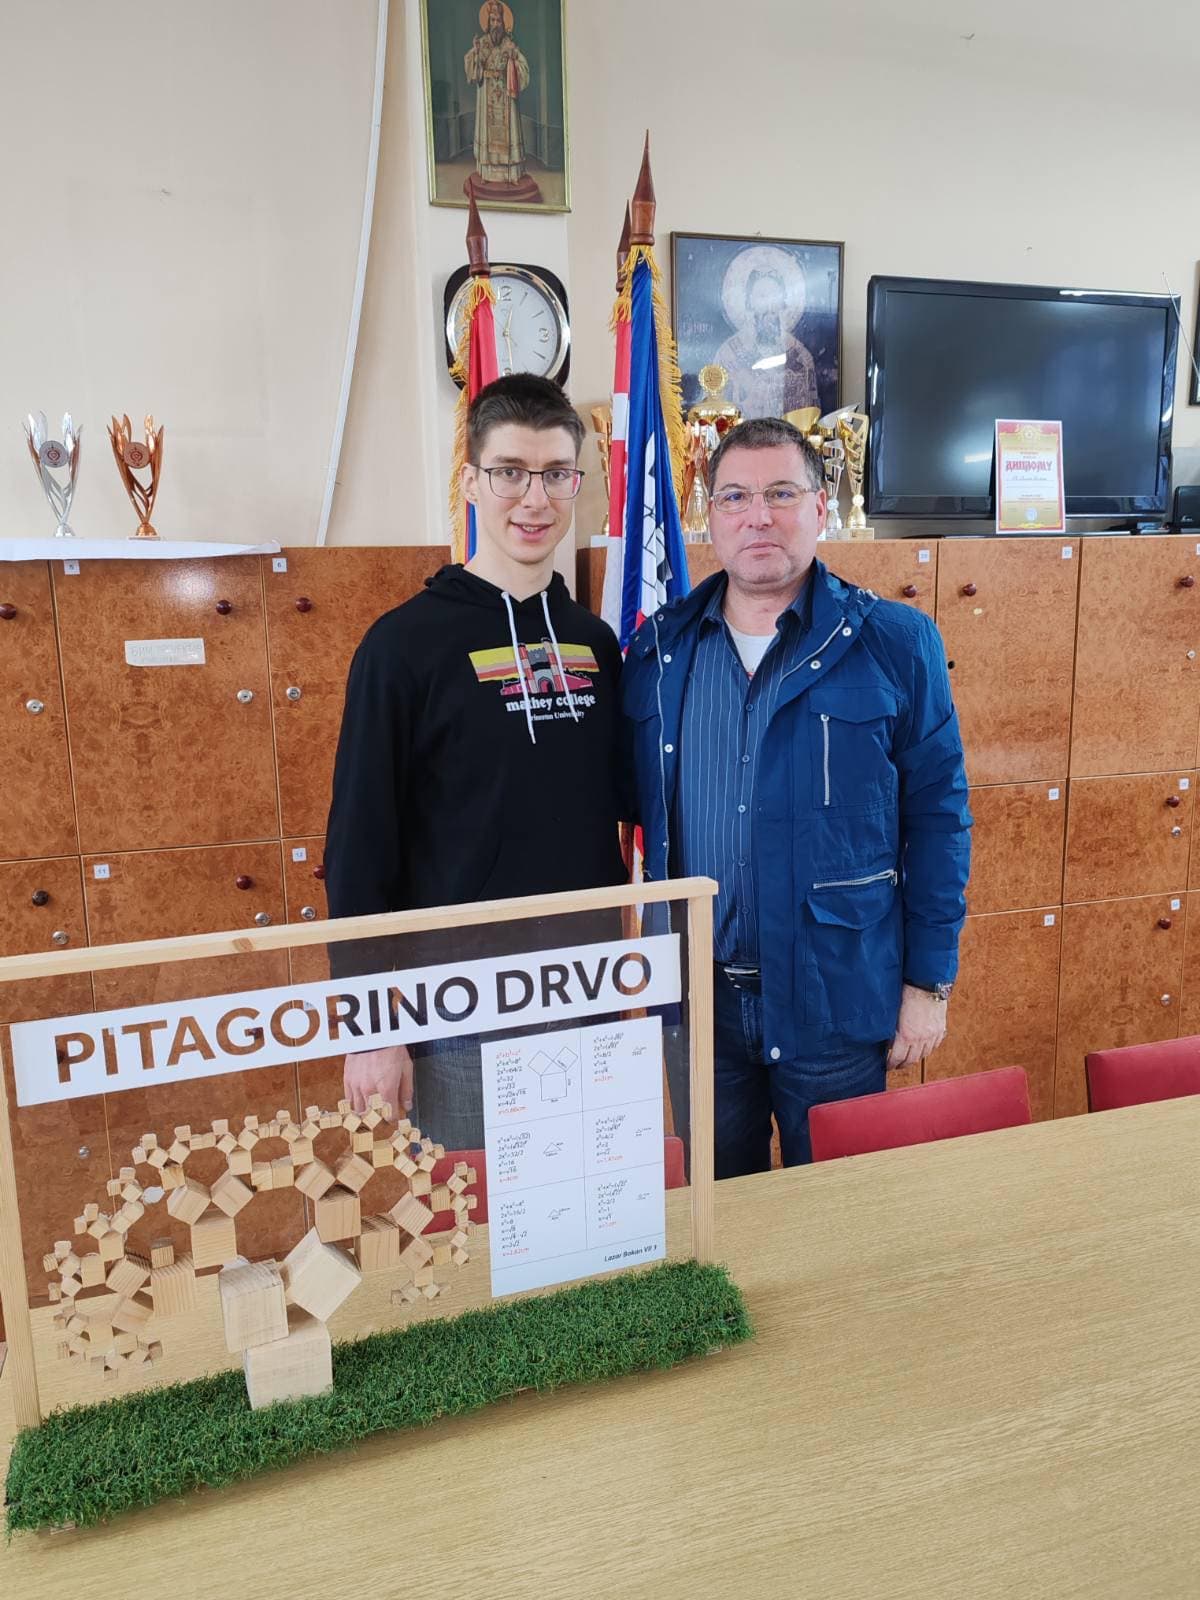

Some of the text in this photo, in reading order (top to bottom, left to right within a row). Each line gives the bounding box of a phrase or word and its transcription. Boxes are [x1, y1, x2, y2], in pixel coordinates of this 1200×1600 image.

[539, 328, 550, 343] 3
[505, 697, 552, 711] mahey
[54, 952, 652, 1083] PITAGORINO DRVO
[604, 1253, 622, 1262] Lazar
